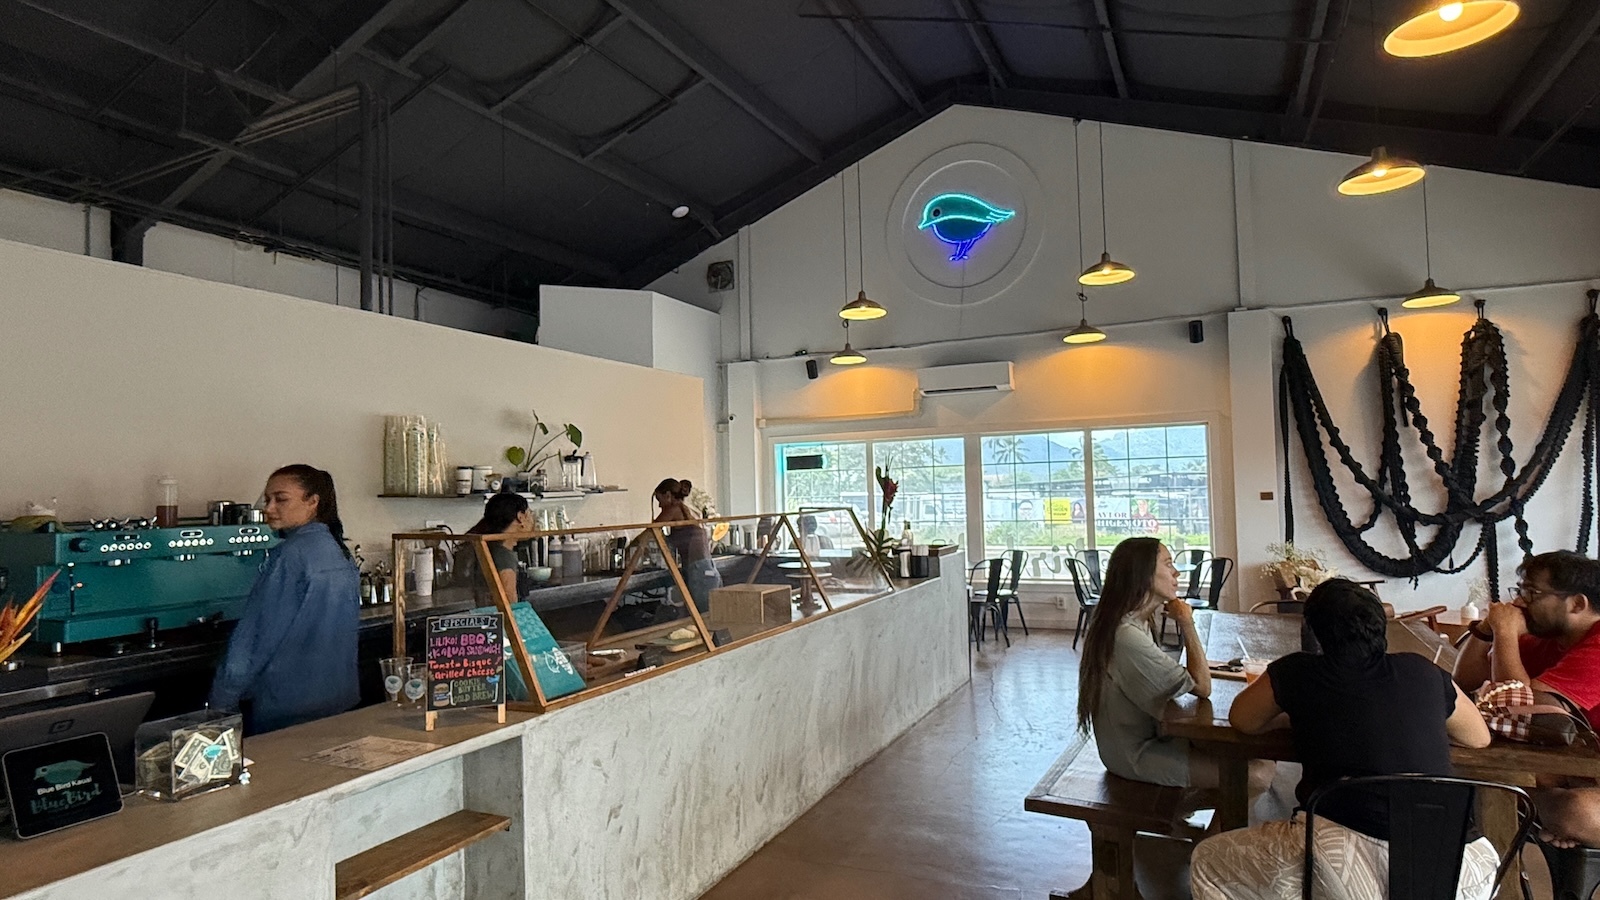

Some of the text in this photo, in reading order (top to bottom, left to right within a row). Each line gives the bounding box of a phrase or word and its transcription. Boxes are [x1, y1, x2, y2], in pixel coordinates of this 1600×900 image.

[1095, 519, 1157, 527] HIGEMOTO
[443, 617, 485, 627] SPECIALS
[460, 633, 486, 646] BBQ
[428, 658, 492, 669] Tomato Bisque
[434, 668, 465, 679] Grilled
[472, 691, 494, 700] BREW
[37, 787, 55, 795] Blue
[54, 782, 72, 791] Bird
